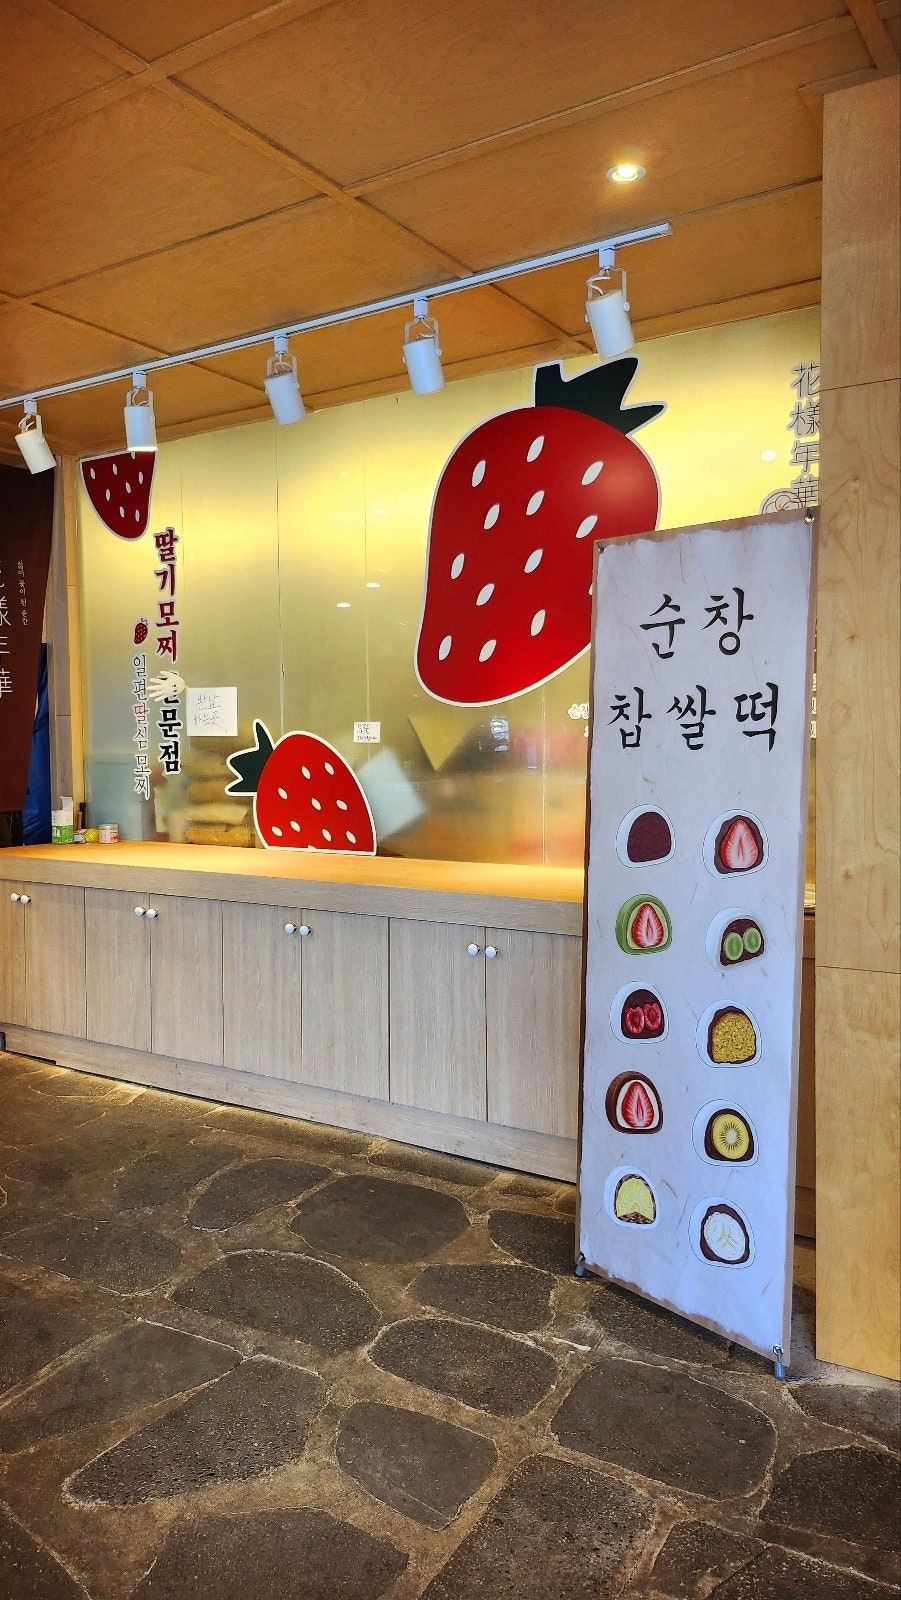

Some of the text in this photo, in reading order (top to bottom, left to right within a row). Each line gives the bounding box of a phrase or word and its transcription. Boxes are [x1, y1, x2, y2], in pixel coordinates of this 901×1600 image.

[21, 609, 28, 626] 순간
[639, 587, 755, 660] 순창
[607, 681, 779, 753] 찹쌀떡
